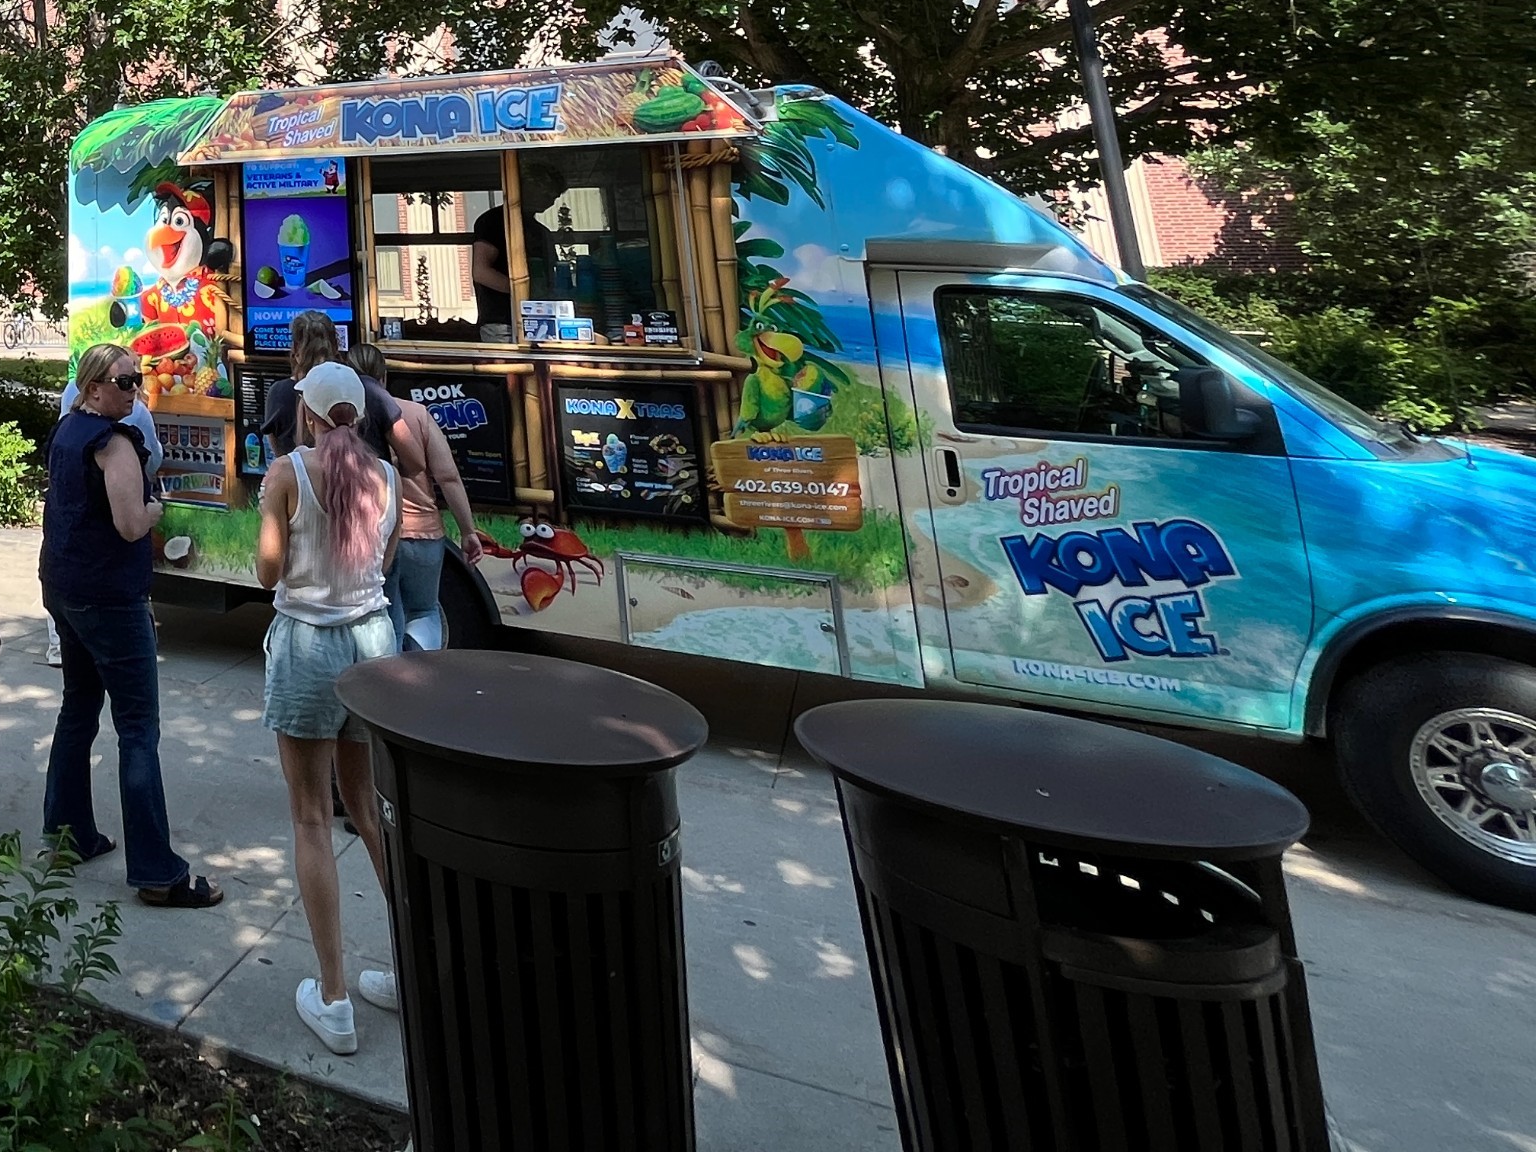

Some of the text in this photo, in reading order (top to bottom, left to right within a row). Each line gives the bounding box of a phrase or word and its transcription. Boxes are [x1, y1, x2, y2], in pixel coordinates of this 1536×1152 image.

[268, 105, 324, 135] Tropical
[341, 84, 562, 145] KONA ICE
[282, 122, 335, 147] Shaved
[246, 172, 293, 181] VETERANS
[246, 179, 319, 190] ACTIVE MILITARY
[253, 311, 283, 321] NOW
[253, 326, 275, 334] COME
[410, 384, 466, 402] BOOK
[426, 398, 488, 430] ONA
[748, 446, 824, 462] KONA ICE
[734, 479, 850, 497] 402.639.0147
[983, 458, 1086, 499] Tropical
[1022, 487, 1117, 525] Shaved
[1000, 519, 1238, 598] KONA
[1074, 591, 1219, 662] ICE
[1013, 659, 1181, 693] KONA-ICE.COM
